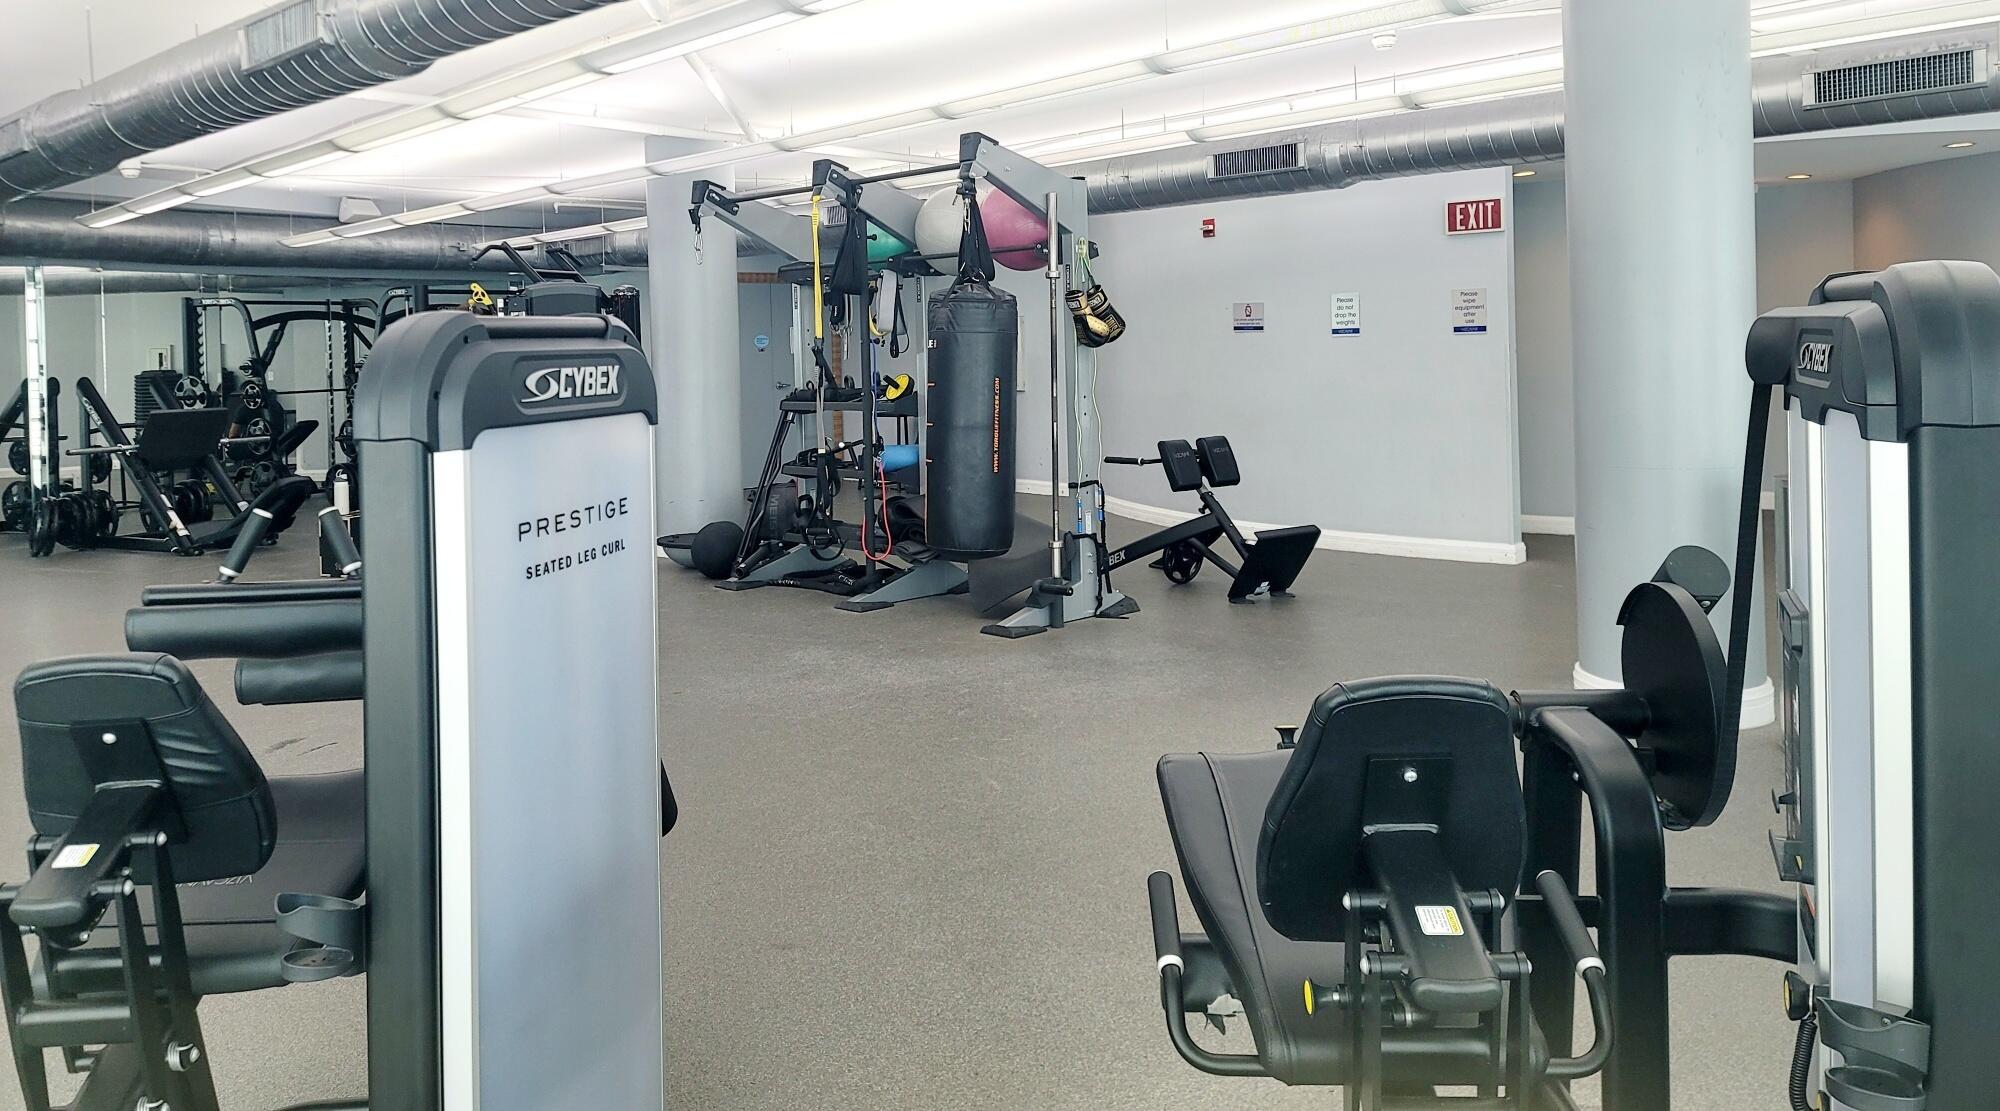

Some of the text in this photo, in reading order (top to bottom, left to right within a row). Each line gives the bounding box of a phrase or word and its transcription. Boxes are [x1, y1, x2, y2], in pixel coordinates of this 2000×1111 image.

[1455, 201, 1495, 230] EXIT
[1806, 343, 1833, 373] CYBEX
[558, 365, 620, 399] CYBEX
[518, 497, 628, 542] PRESTIGE
[526, 538, 626, 580] SEATED LEG CURL
[1109, 550, 1126, 566] BEX
